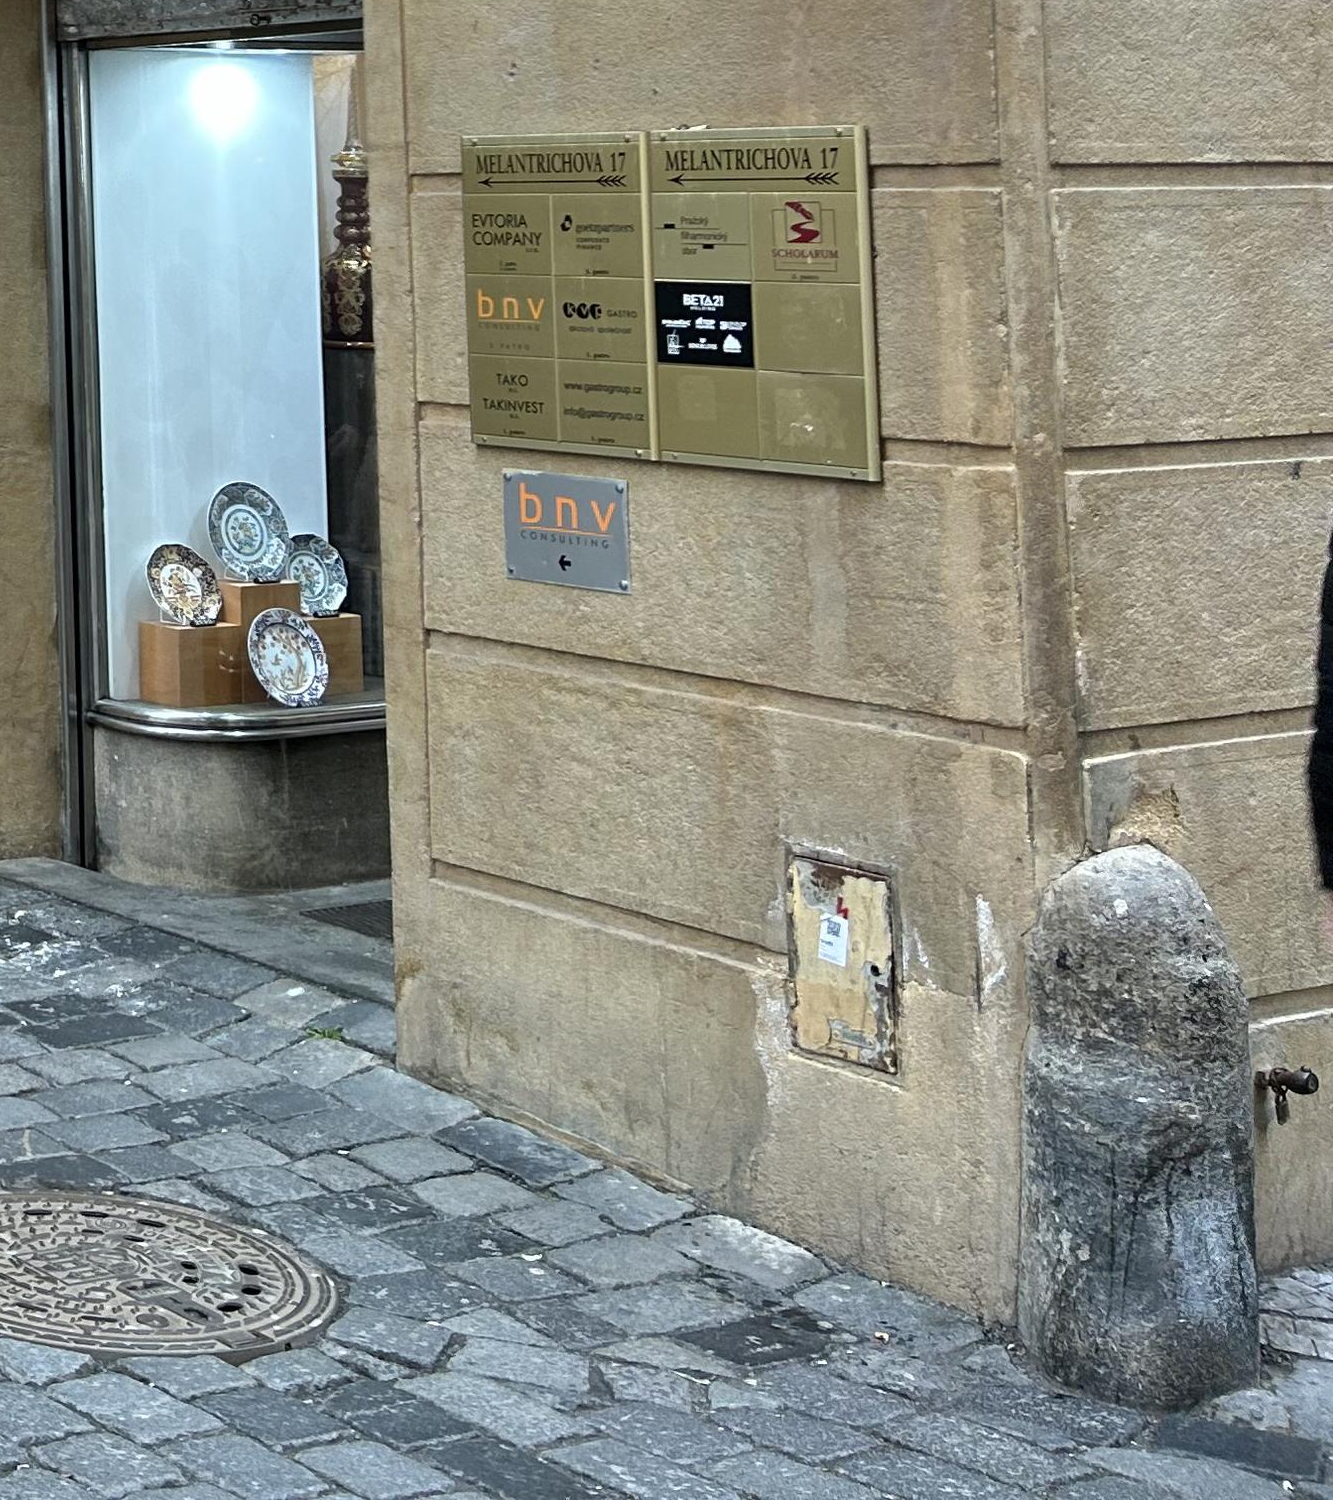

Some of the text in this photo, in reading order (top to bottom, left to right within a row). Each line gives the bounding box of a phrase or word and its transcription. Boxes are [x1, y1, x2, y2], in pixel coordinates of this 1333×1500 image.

[476, 152, 626, 174] MELANTRICHOVA 17
[665, 147, 839, 172] MELANTRICHOVA 17
[471, 213, 528, 228] EVTORIA
[472, 231, 543, 246] COMPANY
[477, 288, 545, 320] bnv
[496, 373, 529, 387] TAKO
[483, 398, 545, 414] TAKINVEST
[518, 482, 617, 532] bnv
[520, 531, 610, 549] CONSULTING
